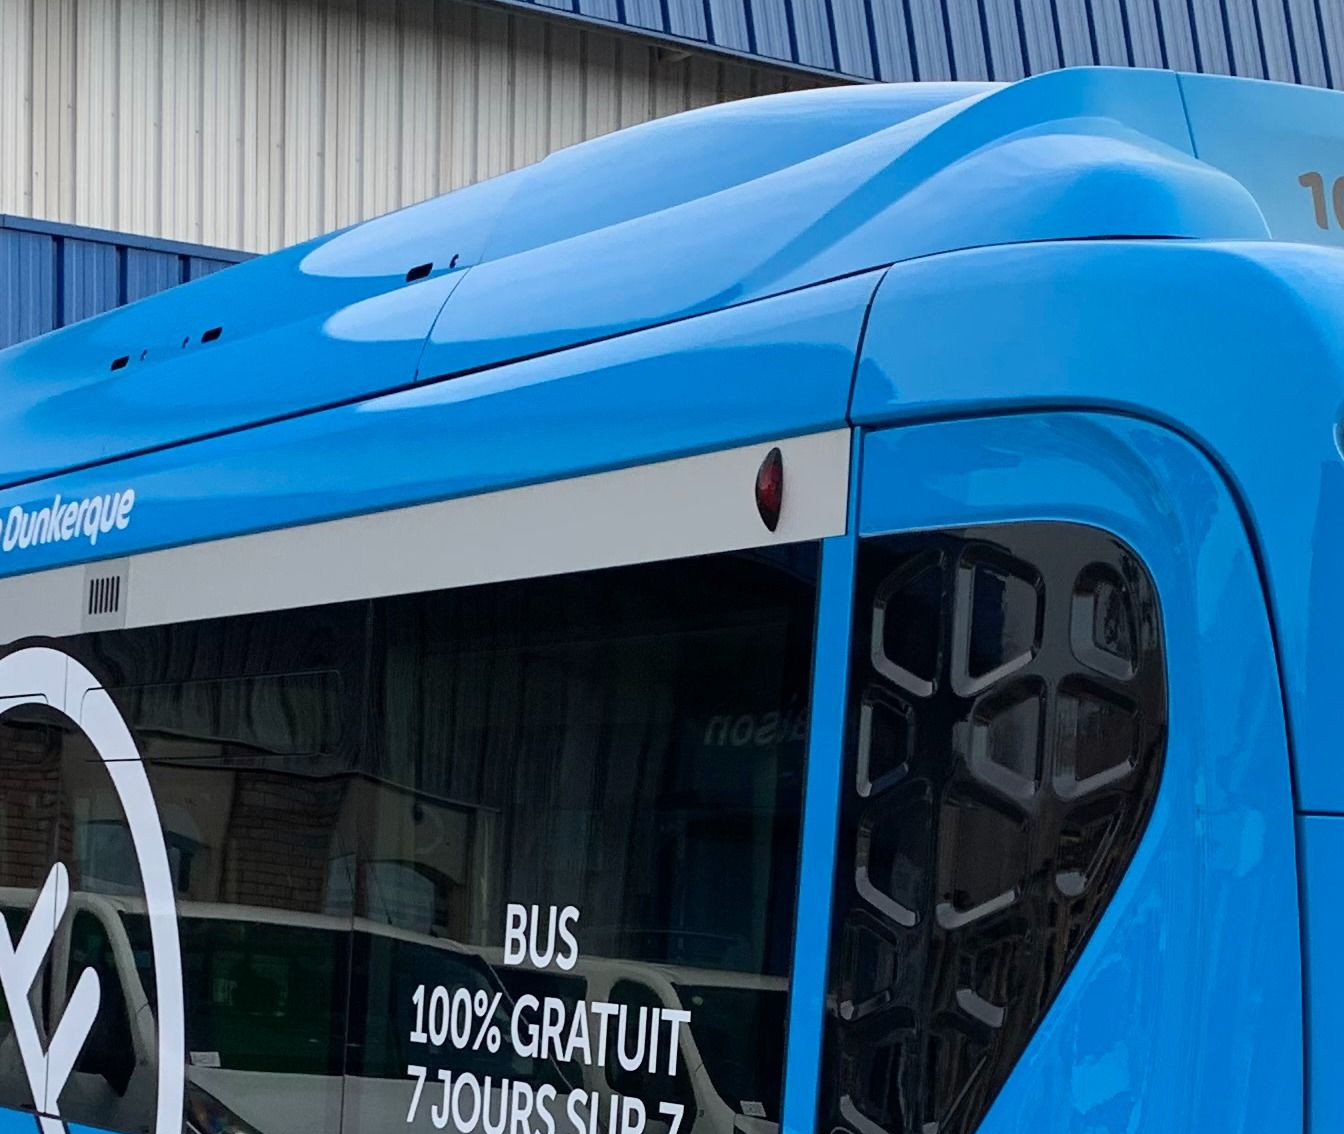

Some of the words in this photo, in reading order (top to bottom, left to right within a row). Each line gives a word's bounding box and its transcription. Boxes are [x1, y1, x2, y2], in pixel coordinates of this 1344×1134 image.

[2, 488, 136, 547] Dunkerque
[504, 903, 580, 971] BUS
[410, 984, 503, 1053] 100%
[511, 994, 692, 1077] GRATUIT
[406, 1065, 427, 1123] 7
